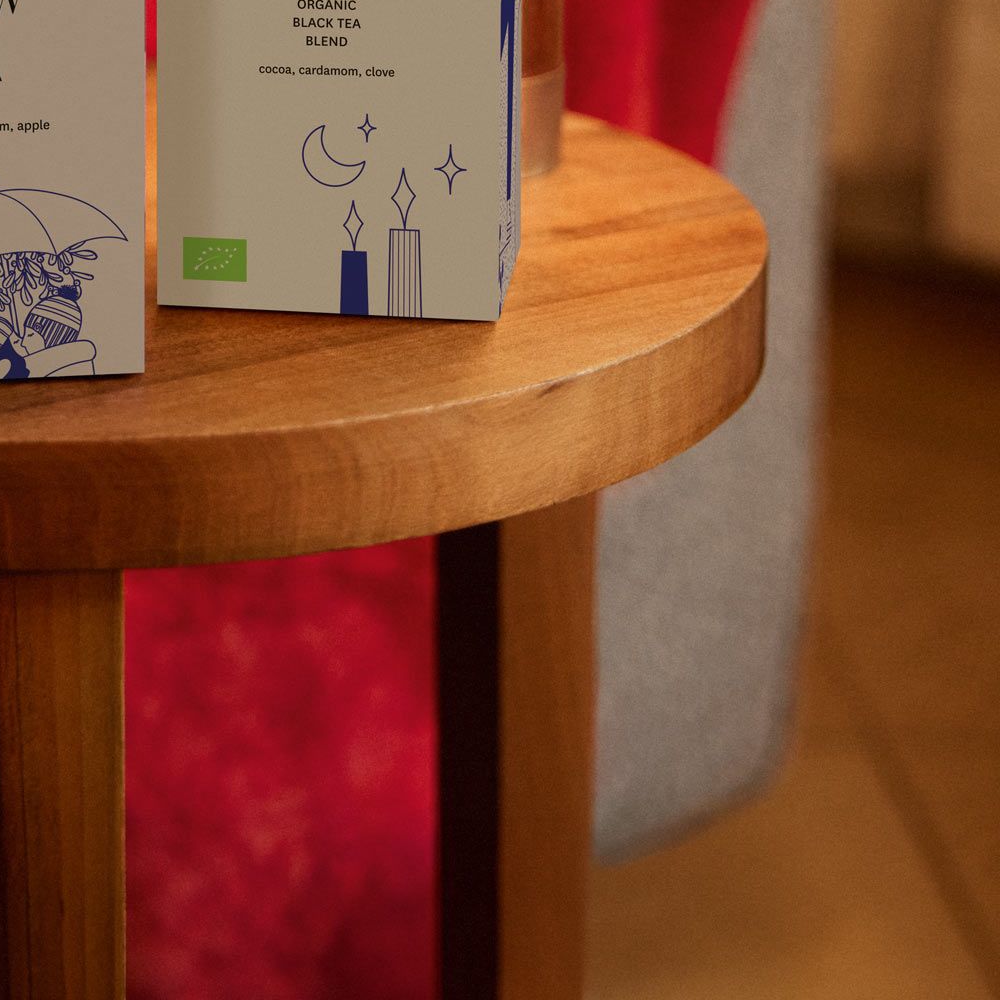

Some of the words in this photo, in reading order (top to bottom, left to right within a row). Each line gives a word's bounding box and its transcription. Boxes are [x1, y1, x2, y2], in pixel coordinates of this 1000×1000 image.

[293, 17, 333, 29] BLACK
[337, 18, 361, 29] TEA
[306, 35, 348, 47] BLEND
[259, 64, 295, 77] cocoa,
[299, 64, 362, 78] cardamom,
[366, 66, 395, 78] clove
[17, 119, 50, 133] apple
